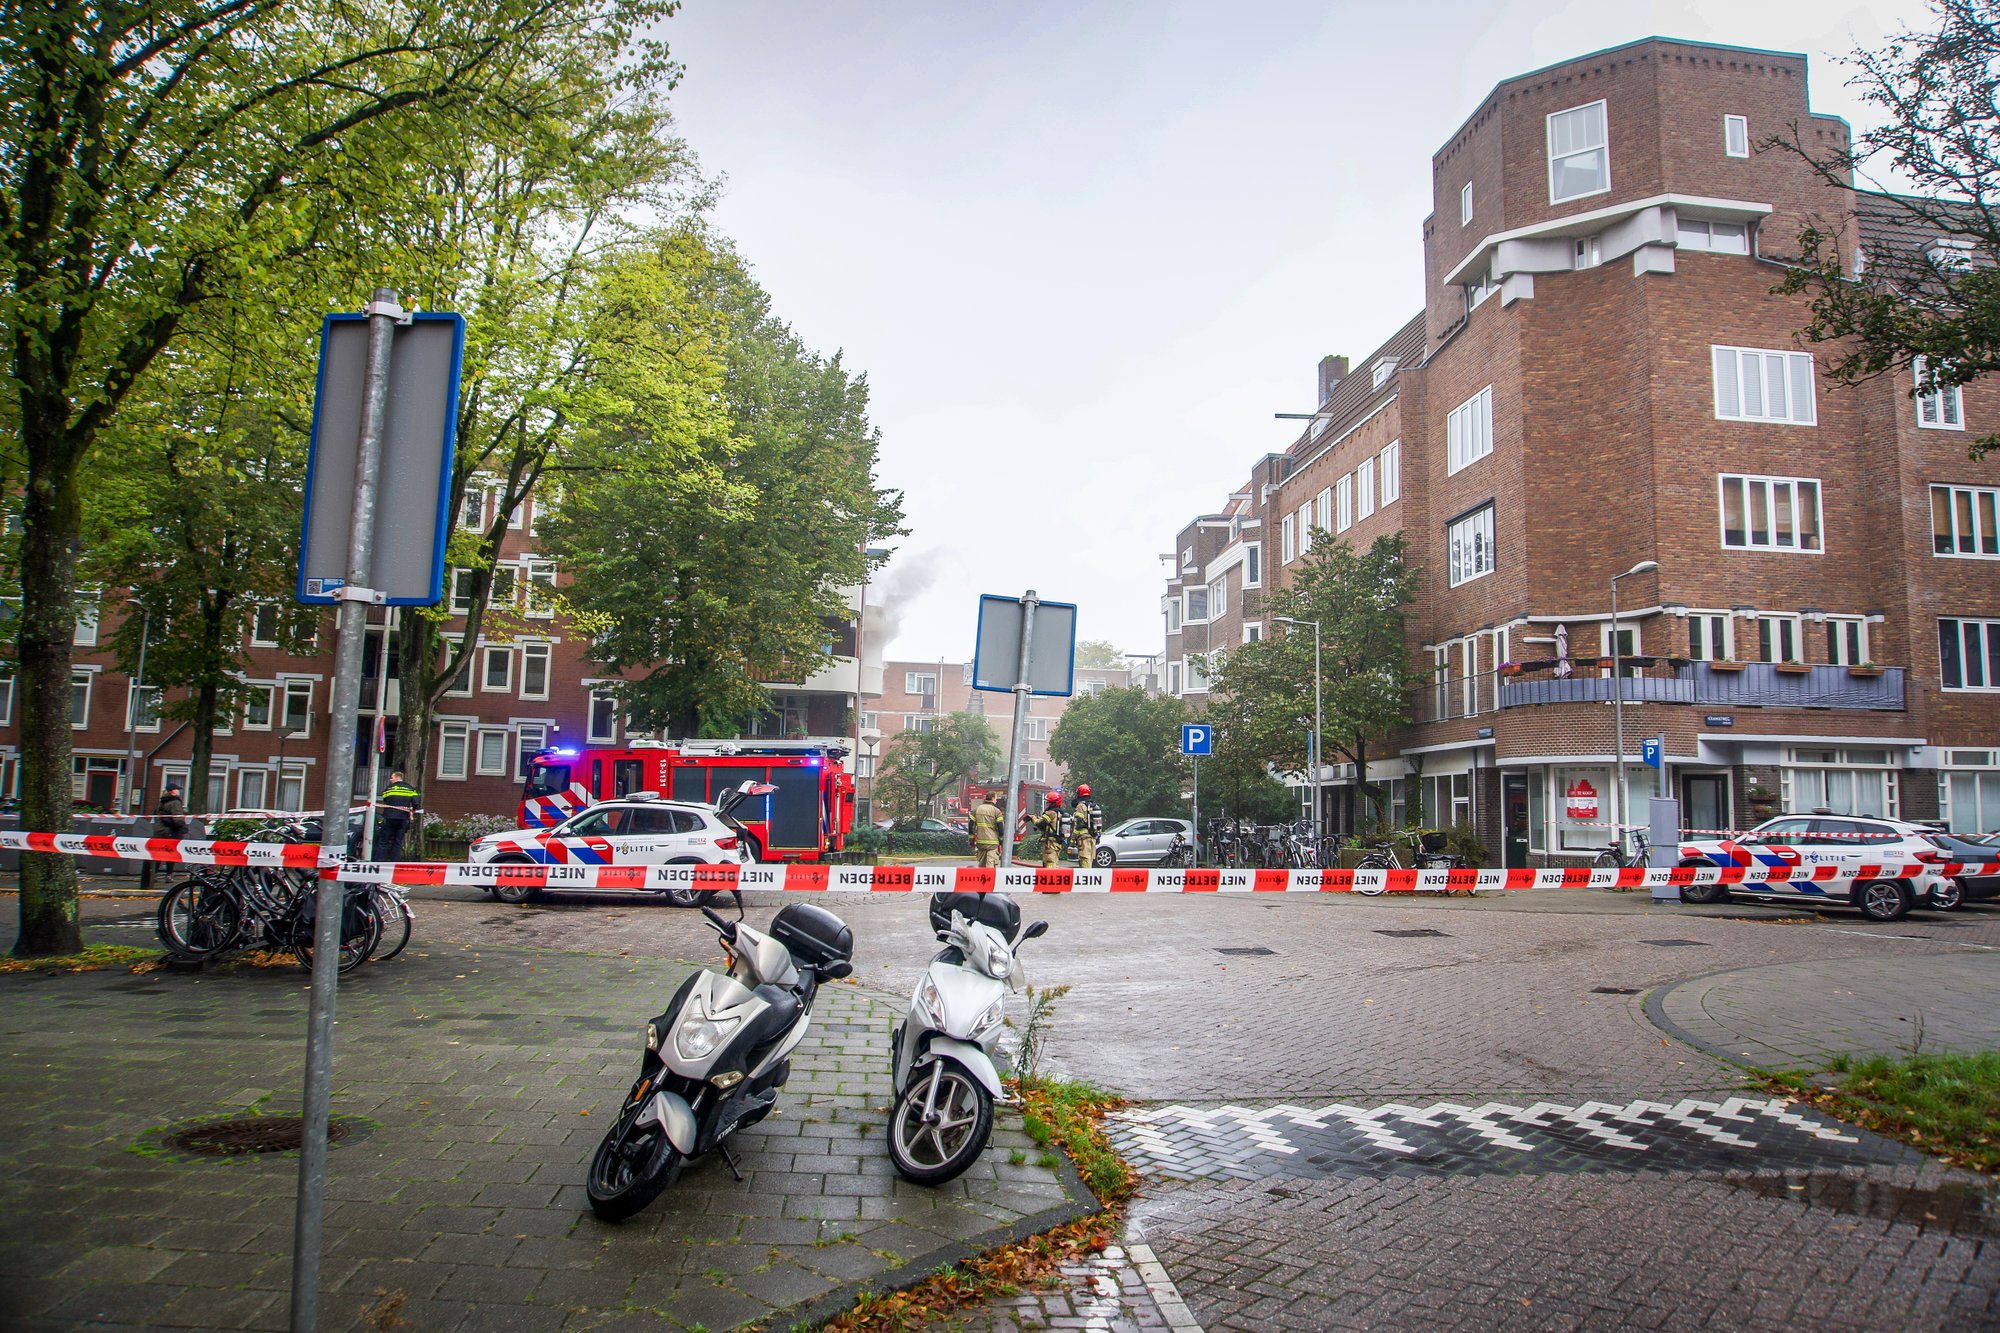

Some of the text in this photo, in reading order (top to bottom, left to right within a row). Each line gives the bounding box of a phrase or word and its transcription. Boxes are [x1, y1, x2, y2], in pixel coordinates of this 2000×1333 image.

[1189, 728, 1205, 751] P
[1647, 746, 1655, 759] P
[115, 842, 140, 853] NIET
[341, 863, 380, 874] NIET
[459, 866, 585, 879] NIET BETREDEN
[1841, 869, 1880, 878] BETREDEN
[1880, 869, 1897, 877] NIET
[658, 869, 773, 883] NIET BETREDEN
[840, 873, 945, 885] NIET BETREDEN
[1005, 874, 1102, 885] NIET BETREDEN
[1157, 875, 1246, 885] NIET BETREDEN
[1296, 875, 1378, 885] NIET BETREDEN
[1424, 875, 1500, 885] NIET BETREDEN
[1541, 874, 1612, 883] NIET BETREDEN
[1650, 872, 1715, 882] NIET BETREDEN
[1750, 871, 1790, 880] BETREDEN
[1791, 871, 1809, 879] NIET
